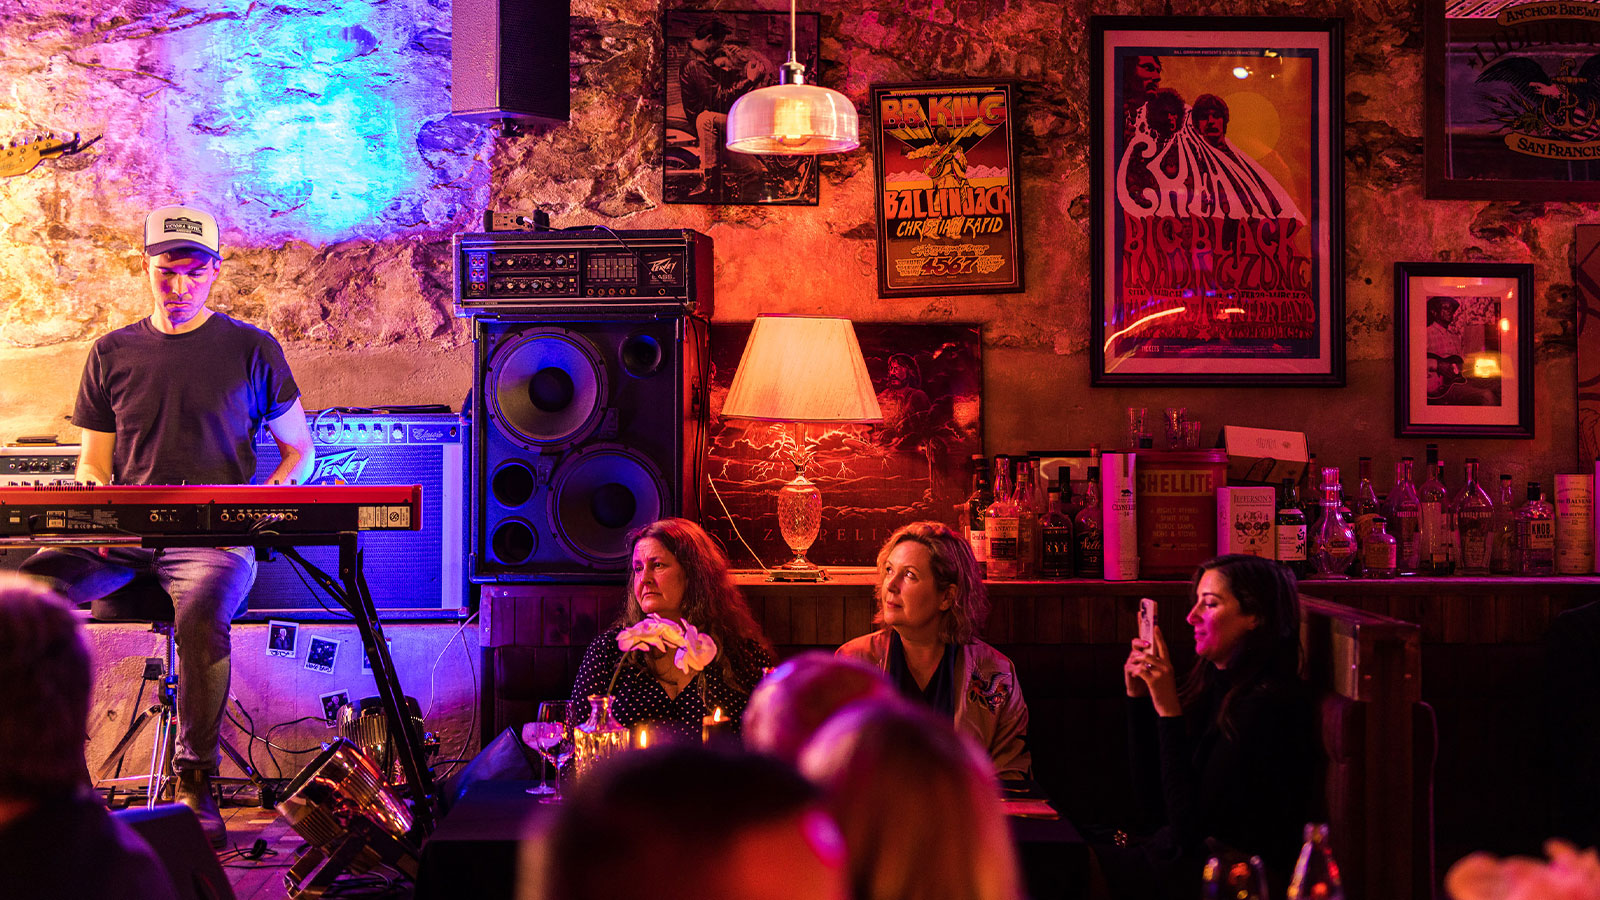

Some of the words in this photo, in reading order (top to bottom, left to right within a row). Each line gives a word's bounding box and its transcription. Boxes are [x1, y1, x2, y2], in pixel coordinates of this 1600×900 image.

[1506, 4, 1558, 23] ANCHOR
[928, 94, 1006, 129] KING
[1517, 137, 1546, 154] SAN
[963, 217, 1004, 239] RAPID
[1123, 216, 1189, 254] BIG
[1190, 215, 1304, 257] BLACK
[310, 448, 369, 484] PEAVEY
[1136, 472, 1213, 493] SHELLITE
[1531, 523, 1551, 534] KNOB
[1045, 544, 1068, 553] RYE
